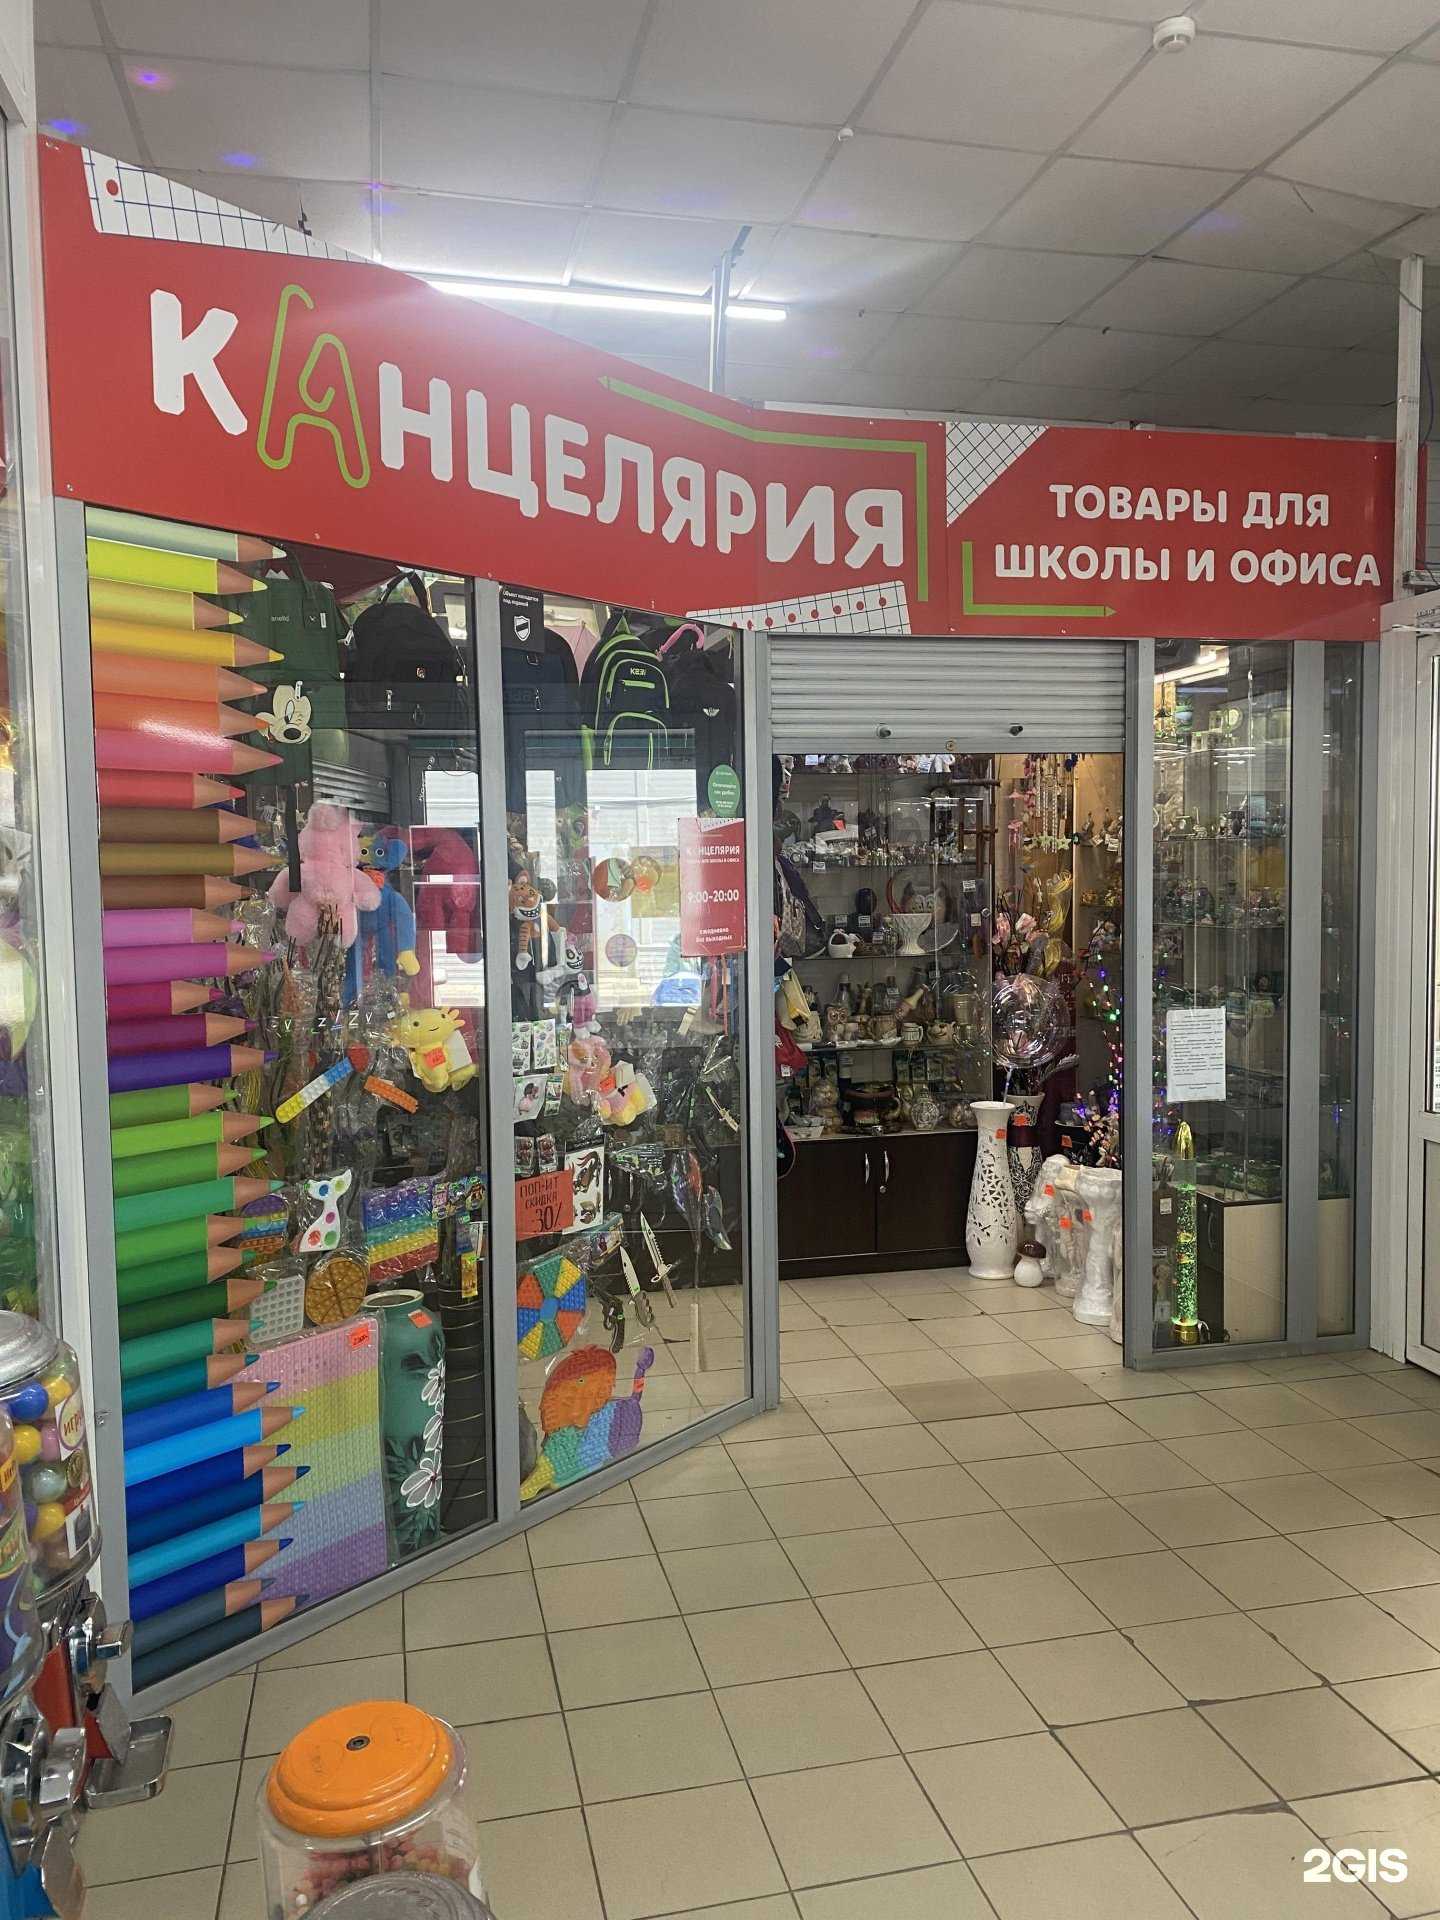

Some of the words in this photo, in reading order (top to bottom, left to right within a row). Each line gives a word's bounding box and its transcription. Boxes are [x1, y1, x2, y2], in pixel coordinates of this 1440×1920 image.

[150, 284, 904, 569] КАНЦЕЛЯРИЯ
[1049, 483, 1228, 524] ТОВАРЫ
[1242, 491, 1330, 530] ДЛЯ
[995, 543, 1171, 581] ШКОЛЫ
[1186, 548, 1215, 583] И
[1230, 547, 1382, 587] ОФИСА
[687, 889, 740, 903] 9:00-20:00
